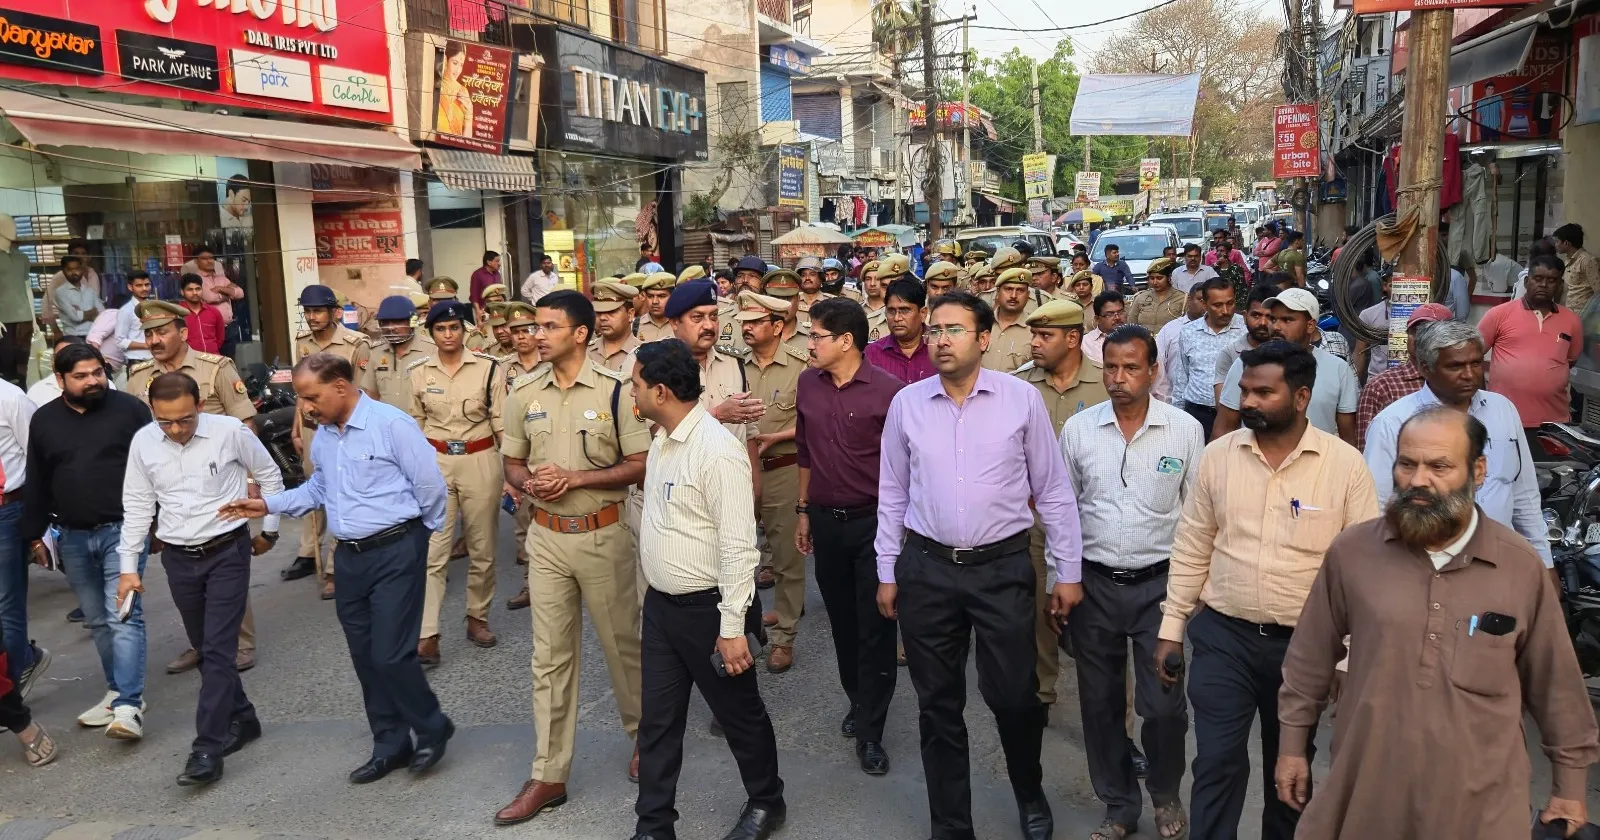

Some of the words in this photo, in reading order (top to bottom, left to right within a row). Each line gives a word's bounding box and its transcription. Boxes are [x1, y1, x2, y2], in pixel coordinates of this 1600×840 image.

[247, 30, 273, 48] DAB.
[274, 35, 296, 53] IRIS
[298, 40, 317, 56] PVT
[319, 43, 338, 59] LTD
[133, 56, 166, 74] PARK
[170, 62, 212, 80] AVENUE
[261, 72, 289, 91] parx
[568, 65, 651, 126] TITAN
[656, 88, 702, 134] EYE+
[1278, 113, 1310, 124] OPENING
[1279, 134, 1294, 142] ₹59
[1281, 152, 1309, 160] urban
[1293, 160, 1311, 168] bite
[334, 233, 372, 250] संवाद
